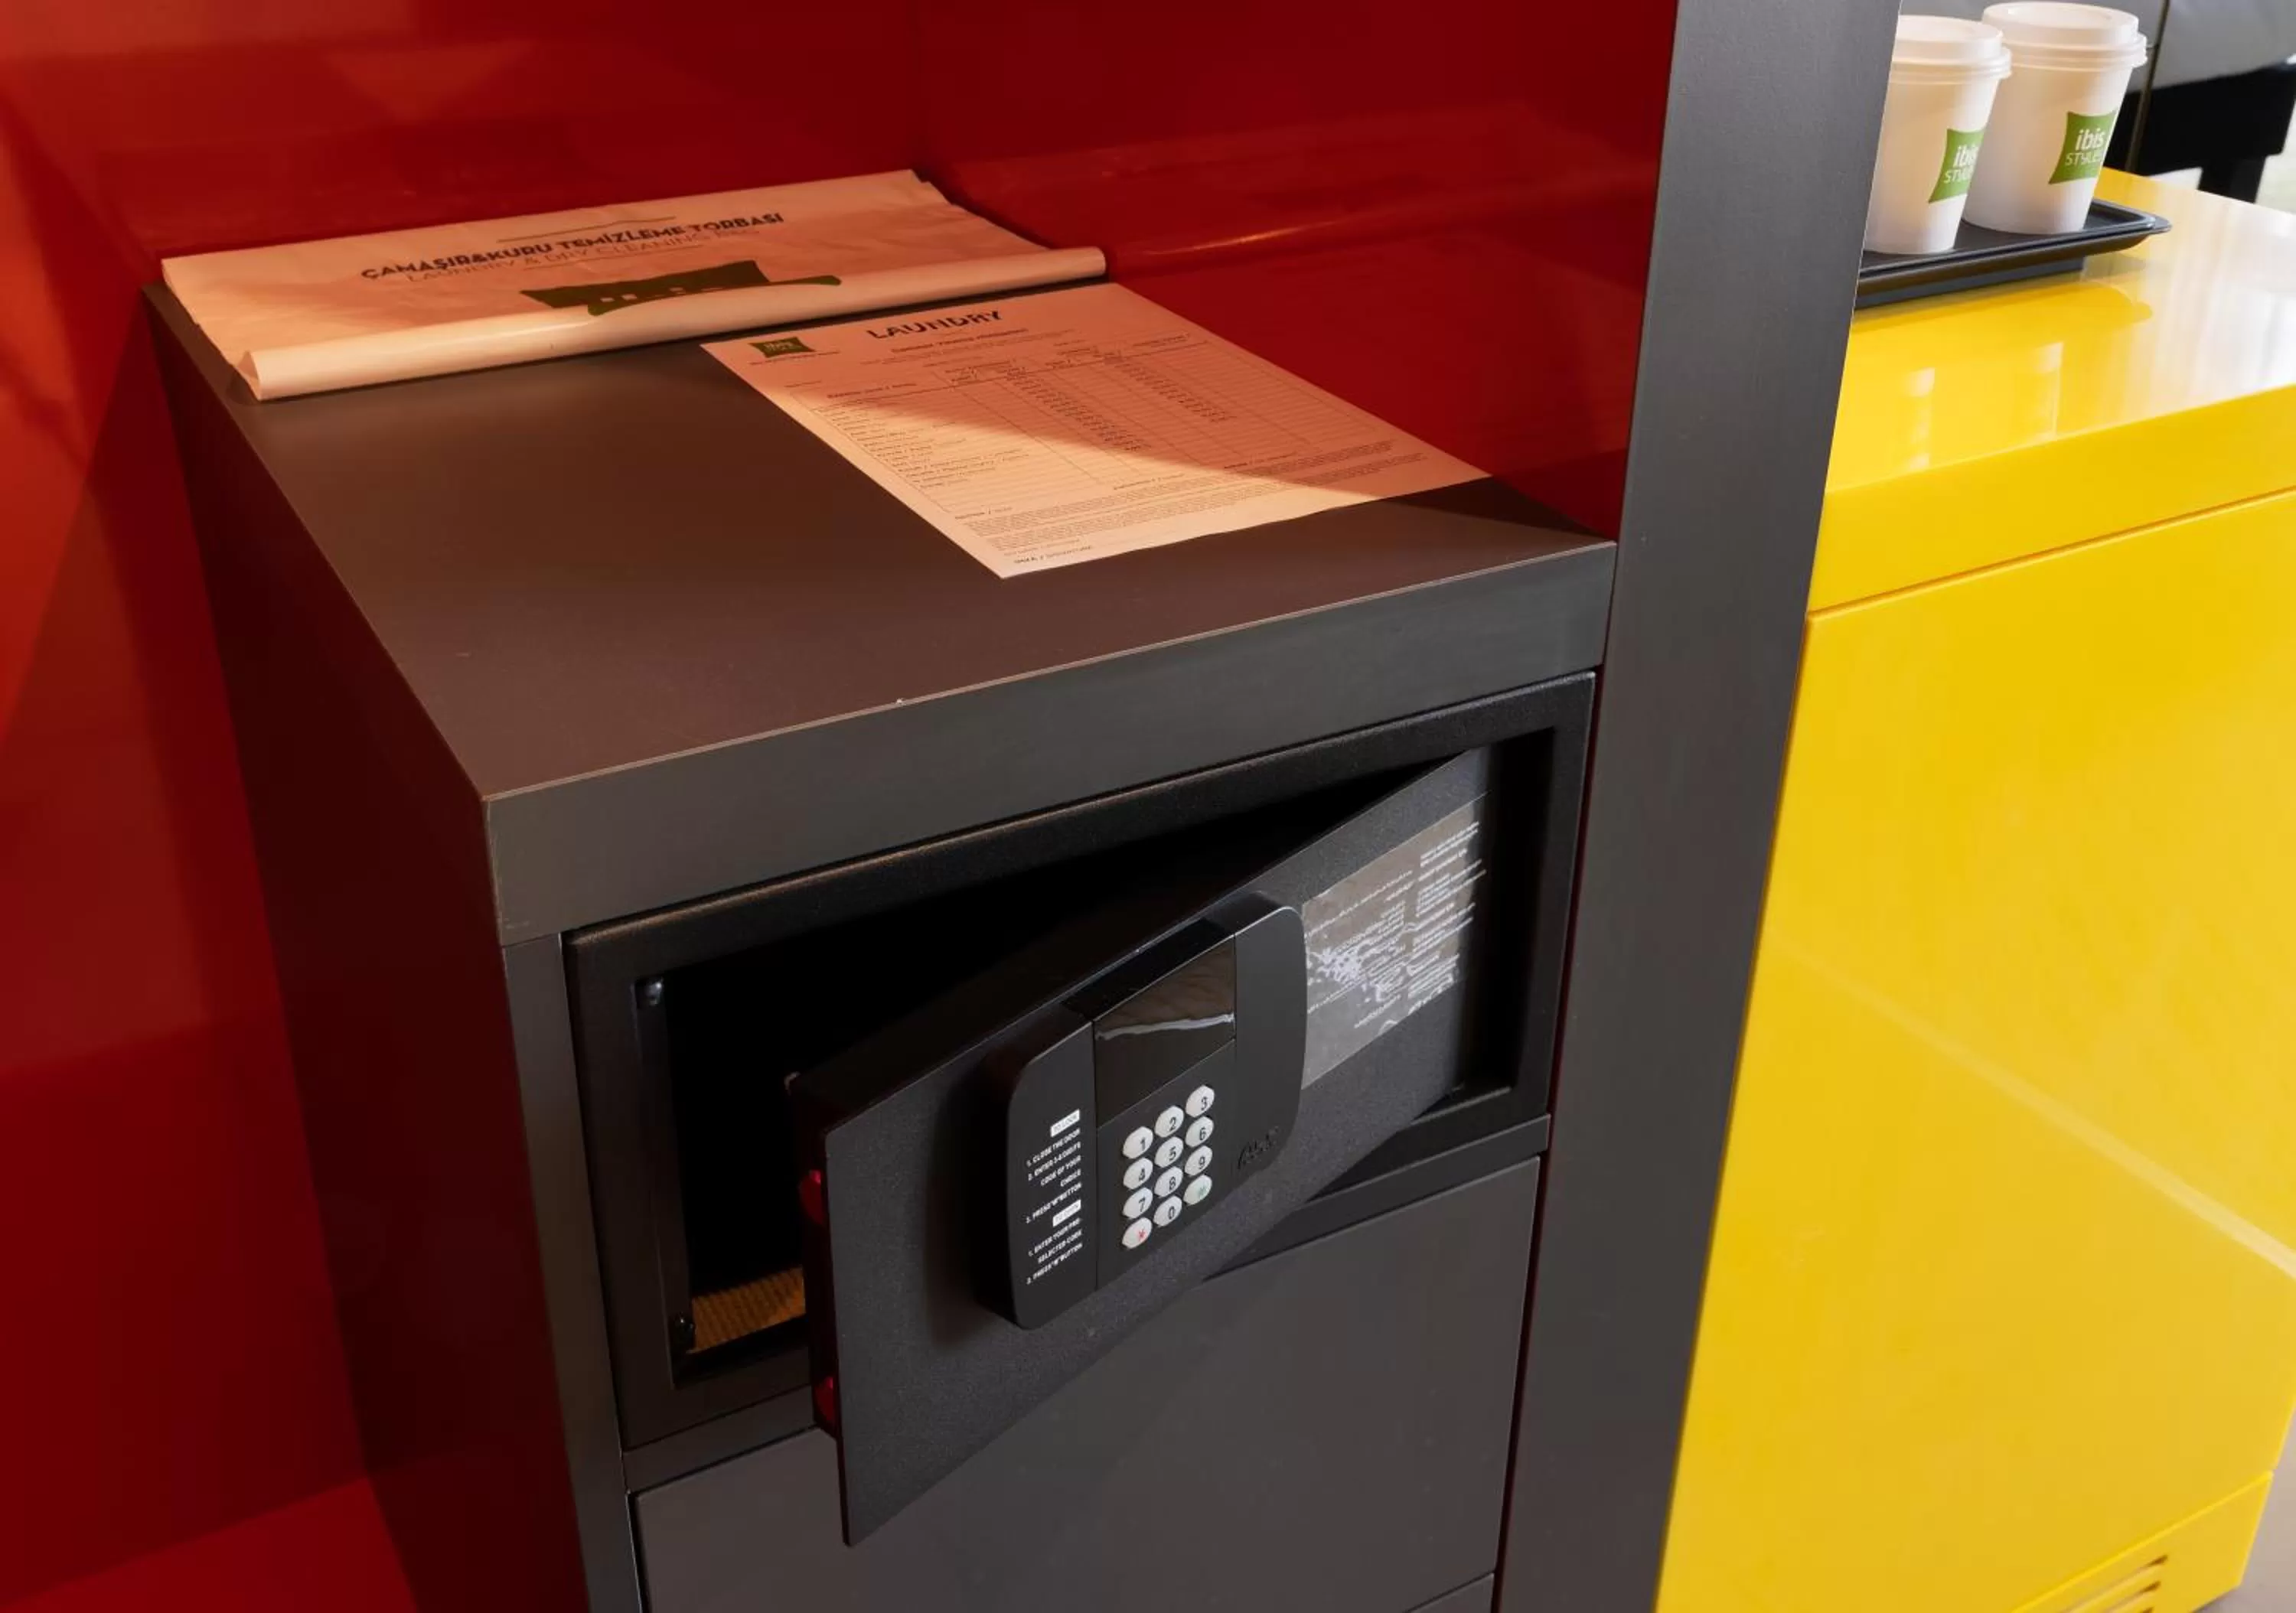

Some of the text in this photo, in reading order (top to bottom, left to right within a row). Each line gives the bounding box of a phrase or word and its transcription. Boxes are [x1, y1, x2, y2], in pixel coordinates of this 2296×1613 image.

[2075, 128, 2105, 151] ibis
[555, 225, 687, 249] TEMİZLEME
[688, 212, 784, 233] TORBASI
[866, 309, 1003, 340] LAUNDRY
[1140, 1096, 1208, 1151] 1 2 3
[1138, 1126, 1207, 1182] 4 5 6
[1138, 1156, 1206, 1212] 7 8 9
[1168, 1206, 1176, 1220] 0
